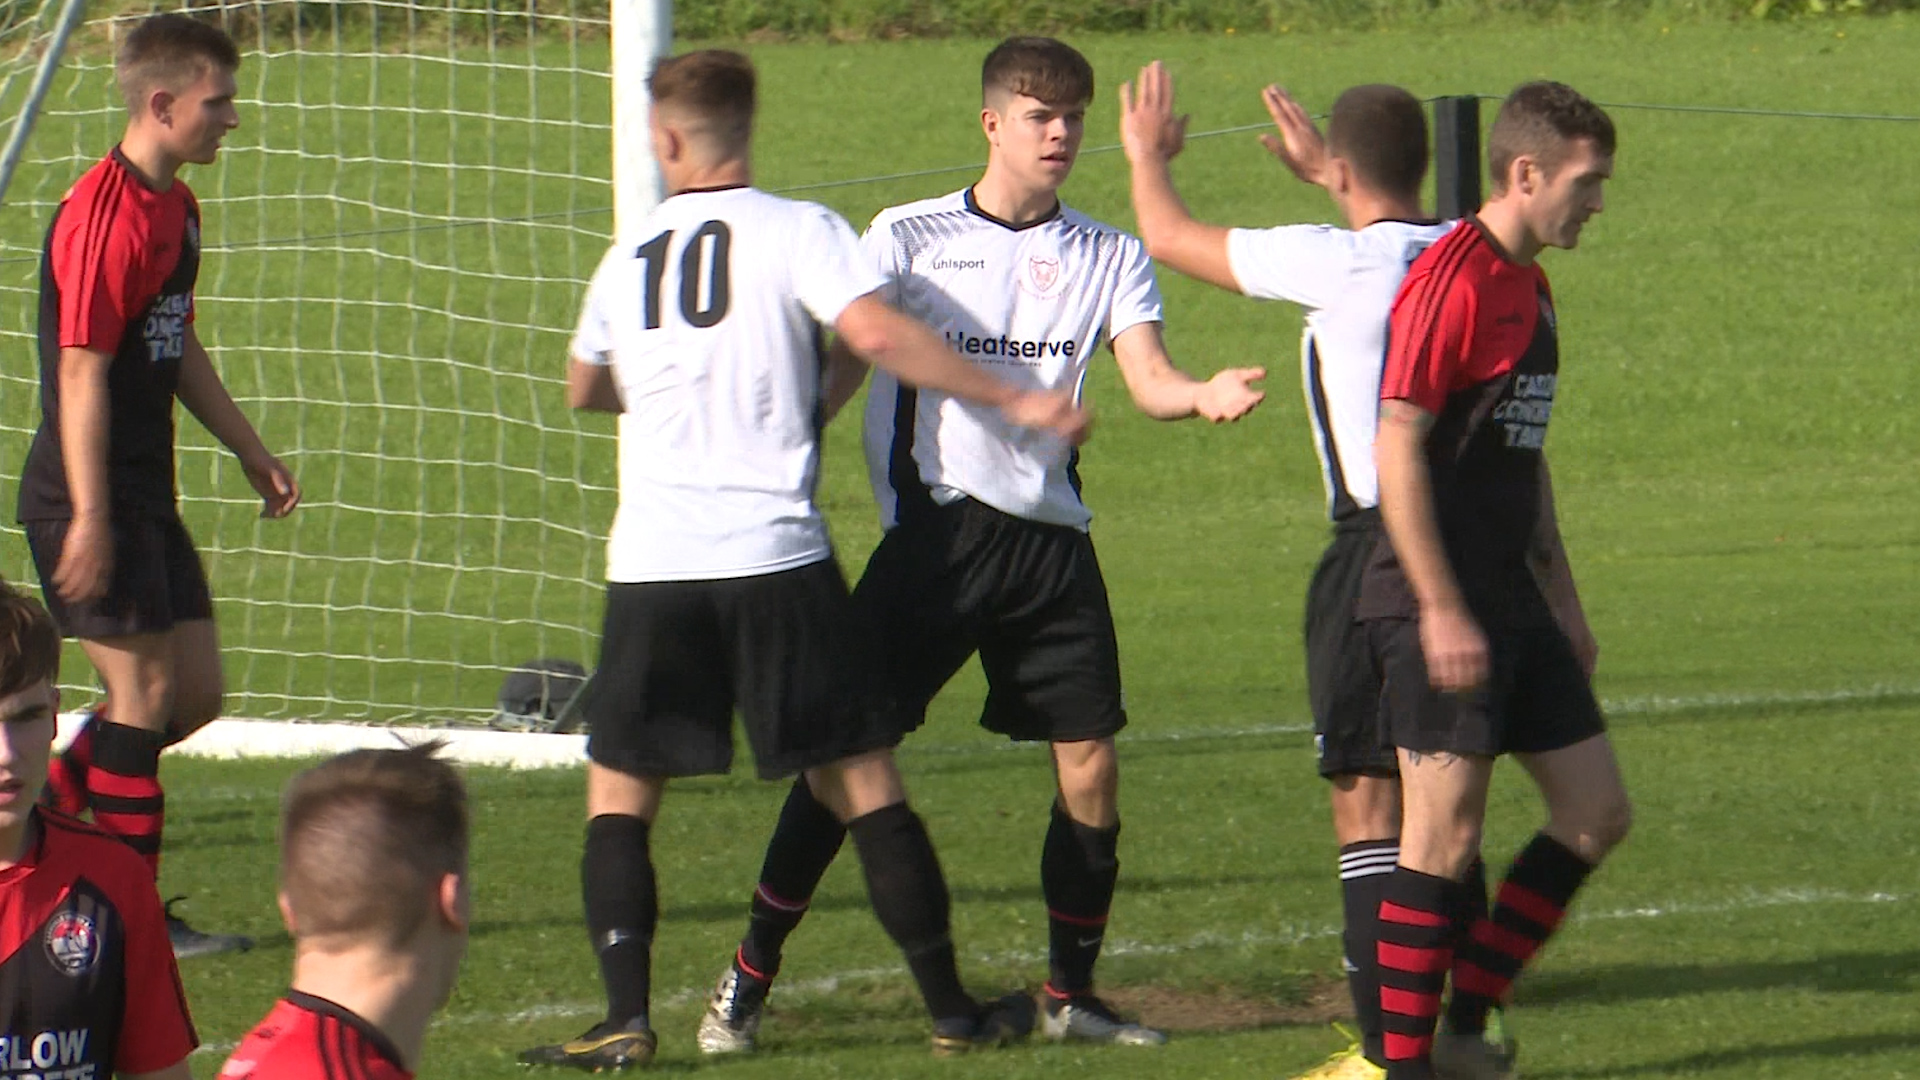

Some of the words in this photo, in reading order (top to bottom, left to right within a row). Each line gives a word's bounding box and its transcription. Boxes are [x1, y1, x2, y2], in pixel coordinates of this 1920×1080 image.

[636, 220, 730, 329] 10
[932, 258, 985, 271] uhlsport
[946, 331, 1075, 358] Heatserve
